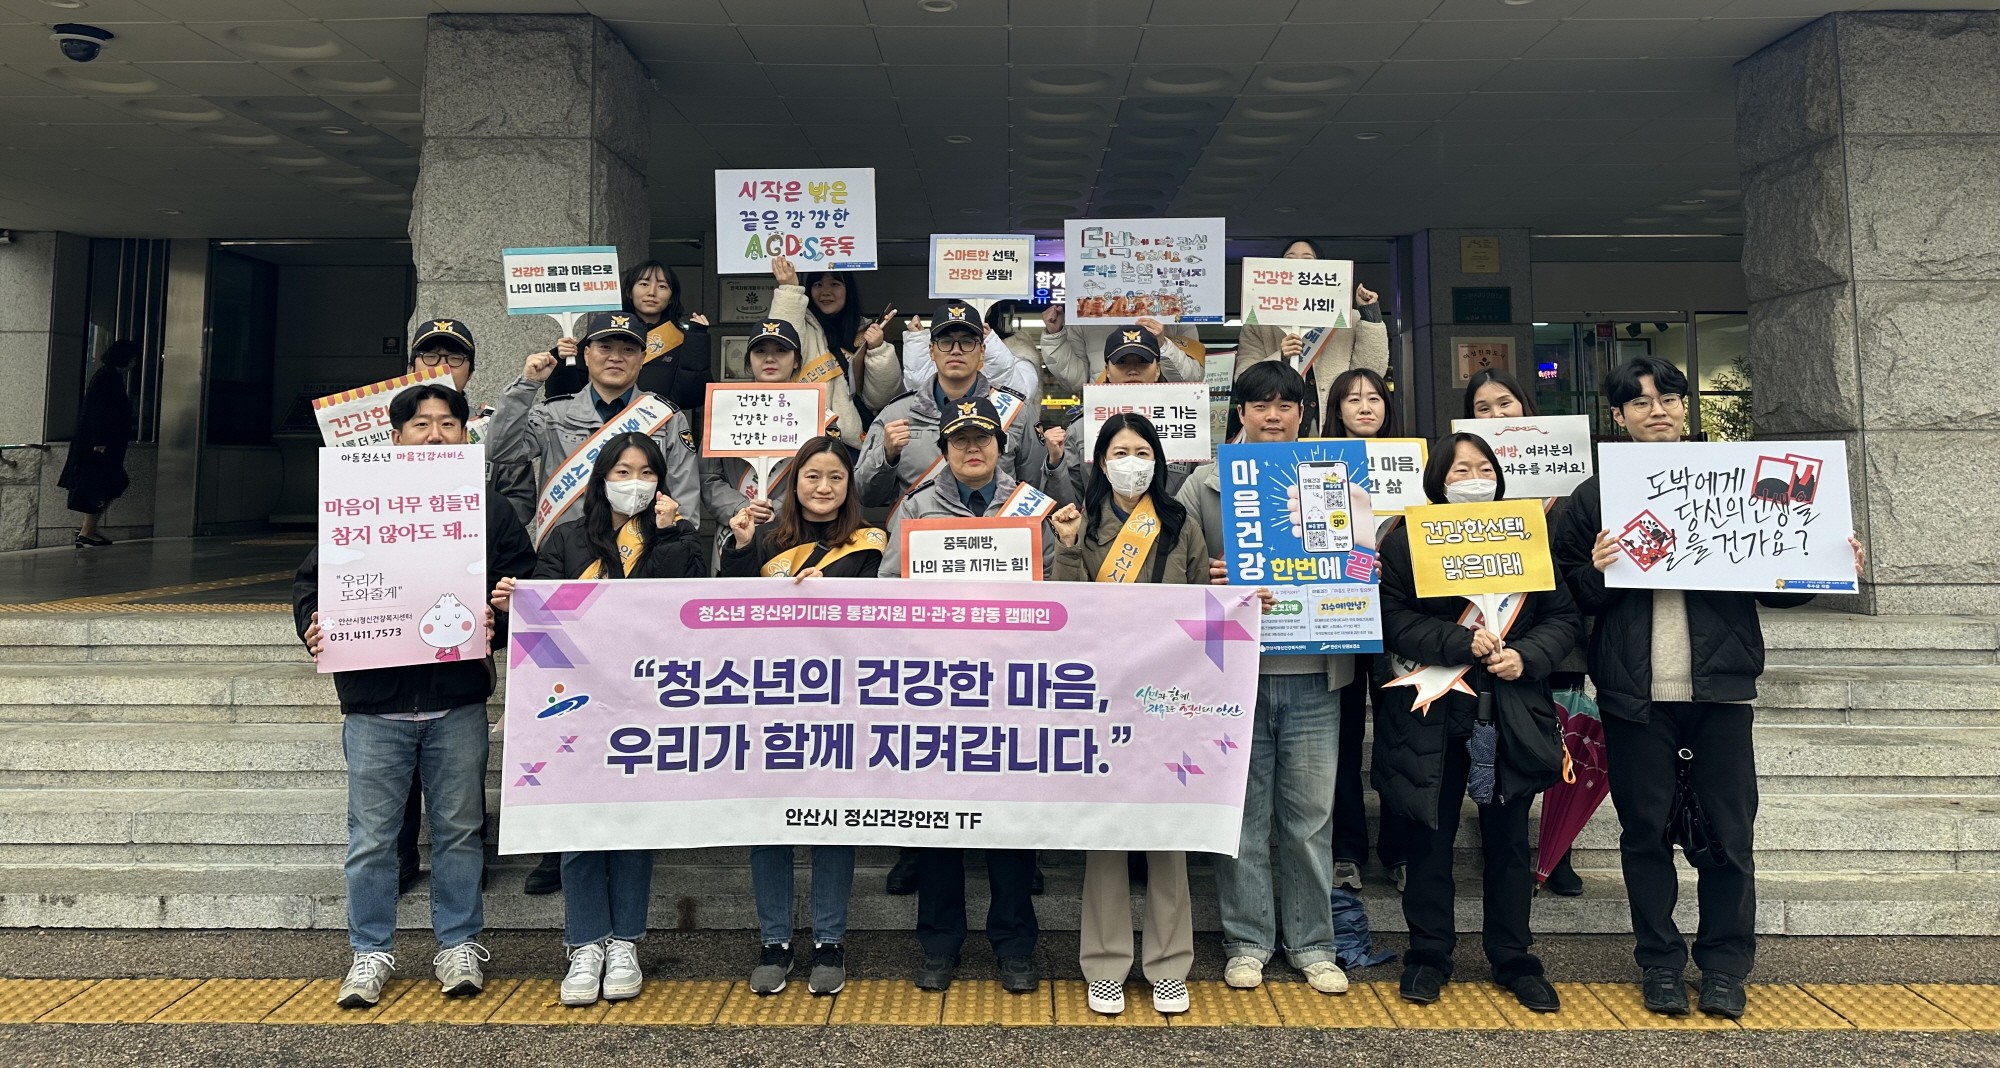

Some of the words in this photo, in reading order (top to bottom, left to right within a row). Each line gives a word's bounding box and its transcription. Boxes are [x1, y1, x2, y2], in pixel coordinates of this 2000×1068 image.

[738, 180, 802, 203] 시작은
[809, 180, 848, 204] 밝은
[739, 210, 779, 231] 끝은
[943, 249, 989, 262] 스마트한
[992, 249, 1019, 264] 선택,
[512, 265, 544, 277] 건강한
[547, 264, 568, 276] 몸과
[572, 264, 613, 276] 마음으로
[948, 269, 983, 282] 건강한
[986, 268, 1012, 281] 생활!
[1082, 264, 1117, 278] 도박은
[1252, 269, 1294, 284] 건강한
[1297, 270, 1341, 287] 청소년,
[510, 281, 532, 294] 나의
[535, 280, 567, 294] 미래를
[570, 281, 580, 292] 더
[583, 280, 617, 292] 빛나게!
[1258, 295, 1299, 310] 건강한
[1303, 296, 1334, 312] 사회!
[737, 394, 773, 407] 건강한
[777, 393, 791, 407] 몸,
[732, 413, 768, 427] 건강한
[773, 413, 798, 427] 마음,
[1170, 406, 1197, 420] 가는
[329, 407, 391, 438] 건강한
[1156, 424, 1196, 438] 발걸음
[731, 433, 767, 446] 건강한
[771, 433, 798, 446] 미래!
[341, 452, 391, 463] 아동청소년
[396, 450, 465, 461] 마음건강서비스
[1526, 444, 1573, 457] 여러분의
[1168, 464, 1185, 472] OLICE
[1381, 455, 1420, 473] 마음,
[1504, 463, 1540, 475] 자유를
[1545, 461, 1585, 474] 지켜요!
[1386, 478, 1402, 494] 삶
[1647, 466, 1745, 500] 도박에게
[324, 498, 380, 517] 마음이
[387, 496, 421, 514] 너무
[428, 494, 480, 513] 힘들면
[1231, 459, 1266, 581] 마음건강
[1270, 556, 1342, 581] 한번에
[1345, 550, 1375, 582] 끝
[1333, 519, 1344, 528] go
[331, 525, 371, 546] 참지
[379, 522, 437, 545] 않아도
[443, 521, 479, 541] 돼...
[1421, 516, 1531, 545] 건강한선택,
[944, 535, 997, 551] 중독예방,
[913, 559, 937, 574] 나의
[942, 559, 966, 574] 꿈을
[970, 558, 1007, 573] 지키는
[1010, 557, 1029, 572] 힘!
[1442, 553, 1523, 580] 밝은미래
[338, 613, 412, 626] 안산시정신건강복지센터
[699, 605, 745, 622] 청소년
[750, 604, 842, 622] 정신위기대응
[846, 604, 907, 622] 통합지원
[911, 606, 966, 623] 민·관·경
[970, 607, 1000, 624] 합동
[1005, 607, 1050, 625] 캠페인
[330, 628, 402, 643] 031.411.7573
[634, 659, 840, 708] “청소년의
[858, 659, 993, 708] 건강한
[1008, 662, 1109, 713] 마음,
[1136, 686, 1167, 705] 시민과
[1145, 704, 1176, 719] 자유로운
[1179, 704, 1213, 718] 혁신도시
[1216, 704, 1244, 717] 안산
[607, 724, 750, 775] 우리가
[764, 722, 854, 770] 함께
[869, 724, 1131, 775] 지켜갑니다.”
[785, 808, 838, 827] 안산시
[844, 808, 949, 829] 정신건강안전
[956, 812, 982, 830] TF
